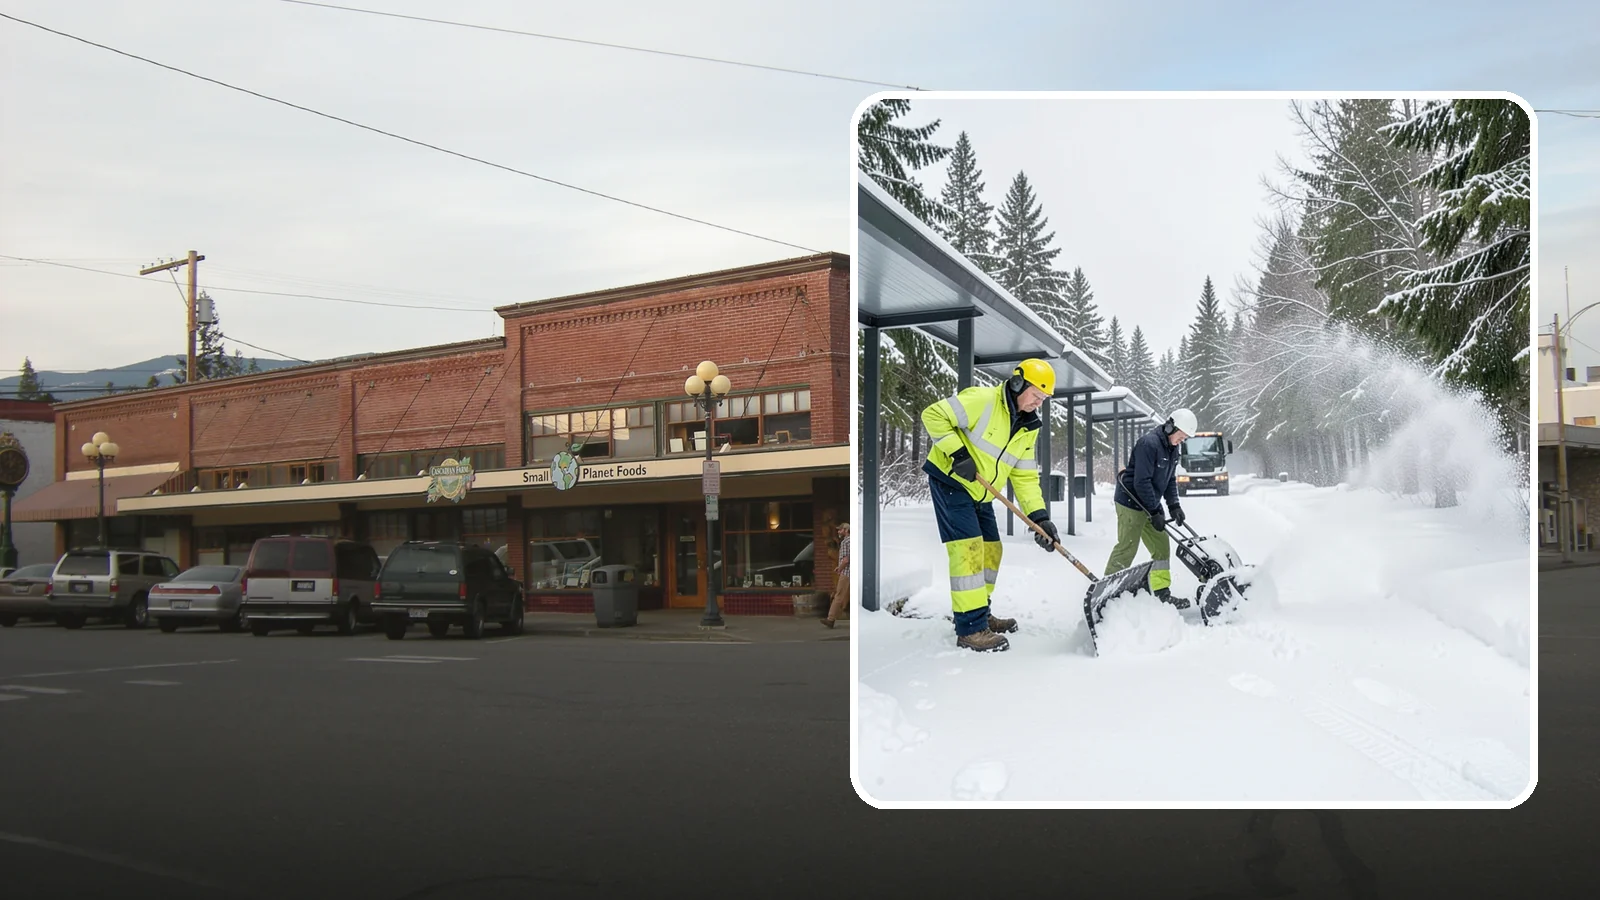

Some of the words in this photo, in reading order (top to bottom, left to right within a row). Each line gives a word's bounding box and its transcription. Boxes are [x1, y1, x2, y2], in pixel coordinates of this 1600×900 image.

[522, 472, 549, 483] Small
[582, 467, 614, 479] Planet
[616, 464, 647, 477] Foods
